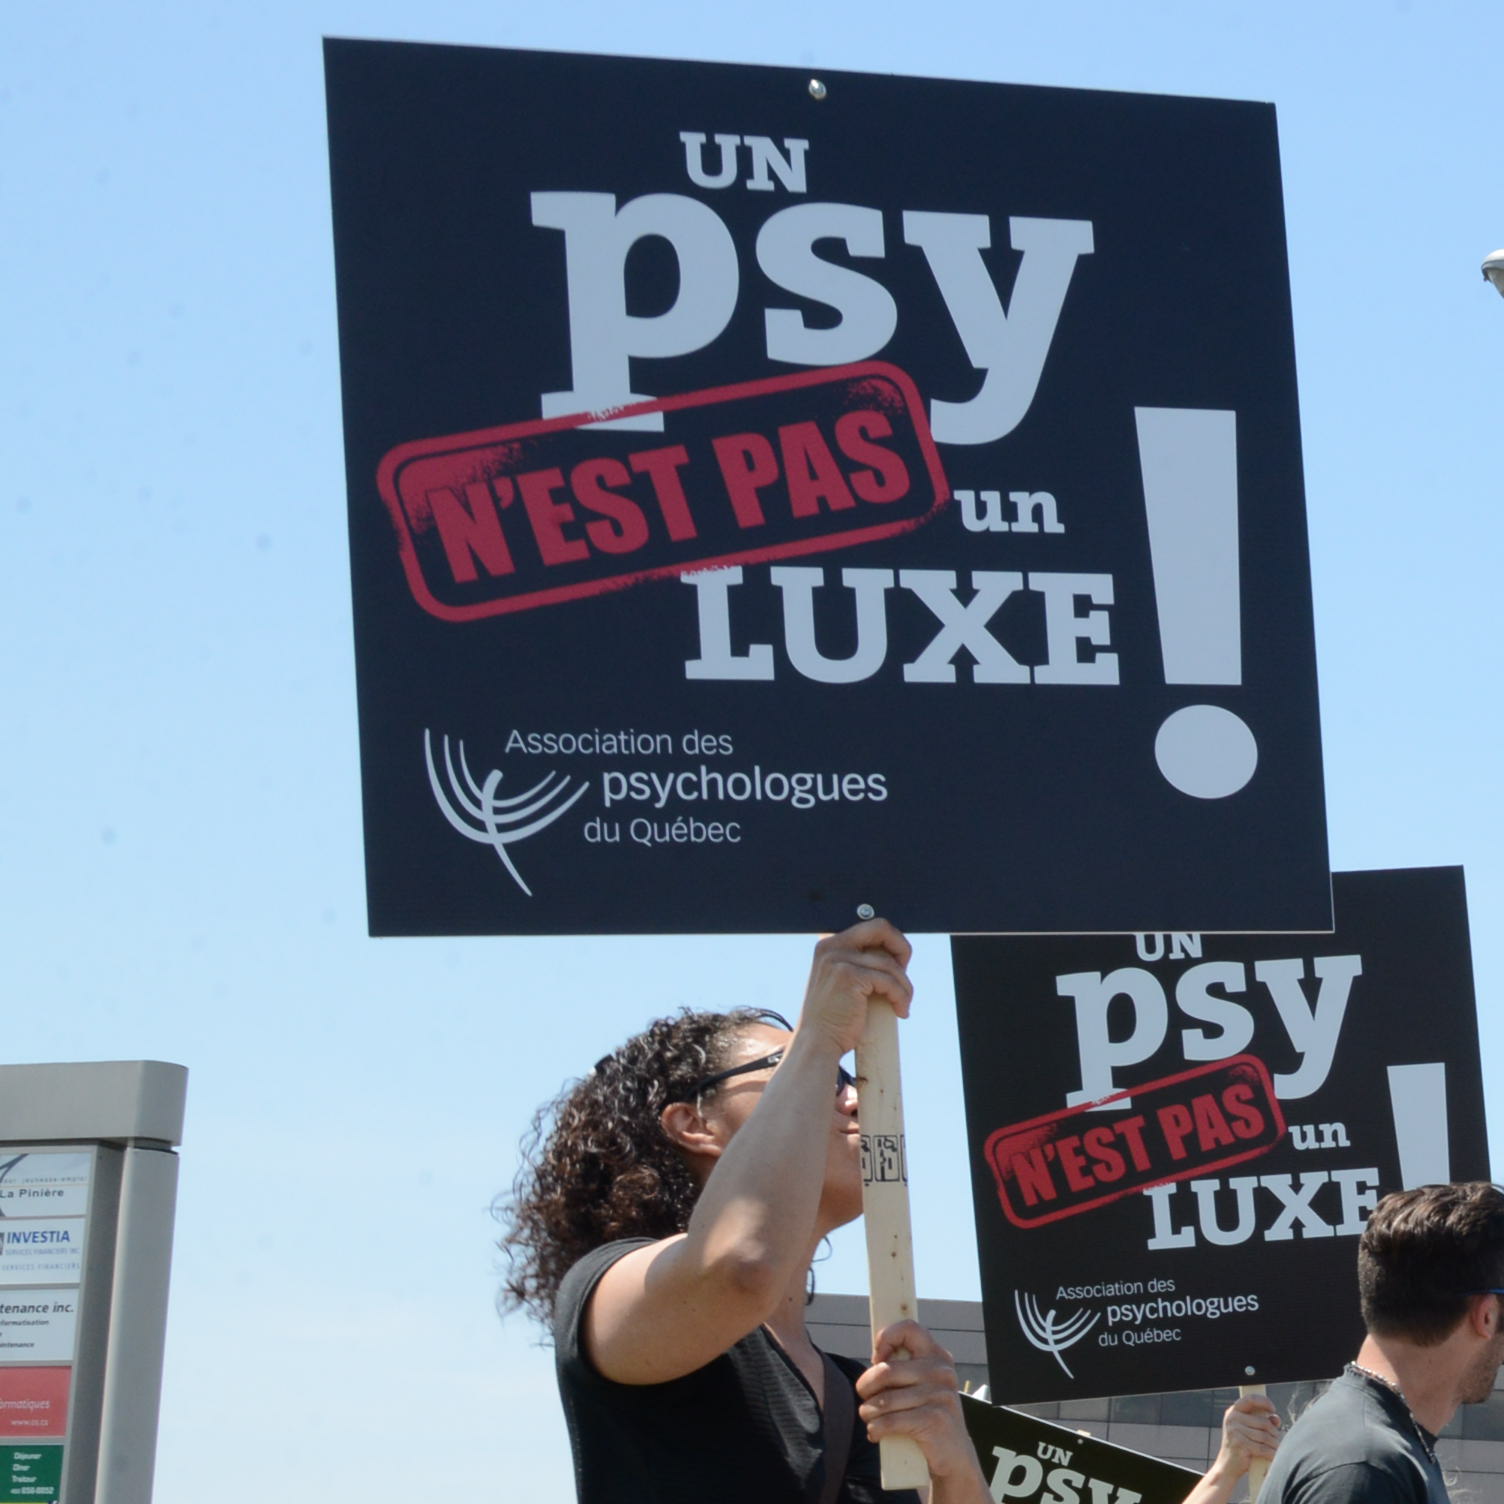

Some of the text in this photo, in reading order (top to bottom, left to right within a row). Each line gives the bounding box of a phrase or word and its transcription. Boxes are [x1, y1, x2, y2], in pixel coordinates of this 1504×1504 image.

[679, 131, 809, 193] UN
[530, 190, 1095, 446] psy
[428, 411, 911, 583] N'EST PAS
[954, 486, 1065, 534] un
[679, 565, 1120, 687] LUXE
[504, 727, 734, 757] Association des
[602, 764, 889, 810] psychologues
[584, 814, 742, 848] du Québec
[1132, 933, 1202, 962] UN
[1055, 955, 1362, 1113] psy
[1010, 1115, 1152, 1207] N'EST
[1156, 1082, 1267, 1161] PAS
[1289, 1121, 1350, 1150] un
[19, 1188, 64, 1198] Pinière
[1143, 1167, 1380, 1250] LUXE
[7, 1230, 70, 1244] INVESTIA
[1056, 1277, 1175, 1300] Association des
[53, 1301, 74, 1313] inc.
[1107, 1292, 1259, 1325] psychologues
[1098, 1326, 1182, 1347] du Québec
[1037, 1441, 1073, 1466] UN
